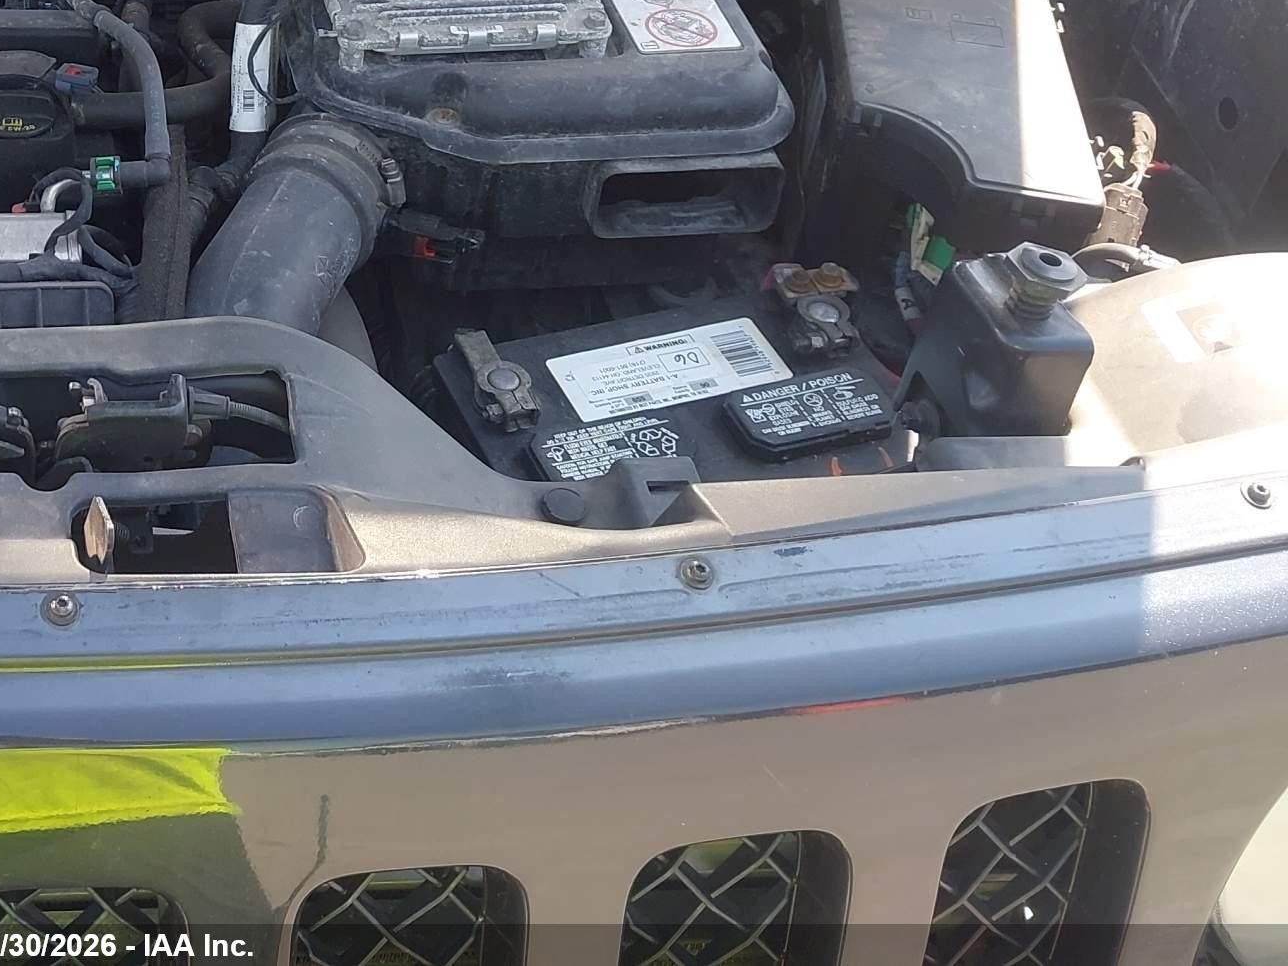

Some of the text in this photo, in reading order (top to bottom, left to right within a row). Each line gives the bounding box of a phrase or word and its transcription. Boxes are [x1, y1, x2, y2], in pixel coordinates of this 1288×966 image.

[632, 376, 666, 388] BATTERY
[666, 373, 679, 381] A-1
[606, 384, 630, 393] SHOP,
[751, 384, 801, 402] DANGER
[808, 372, 853, 389] POISON
